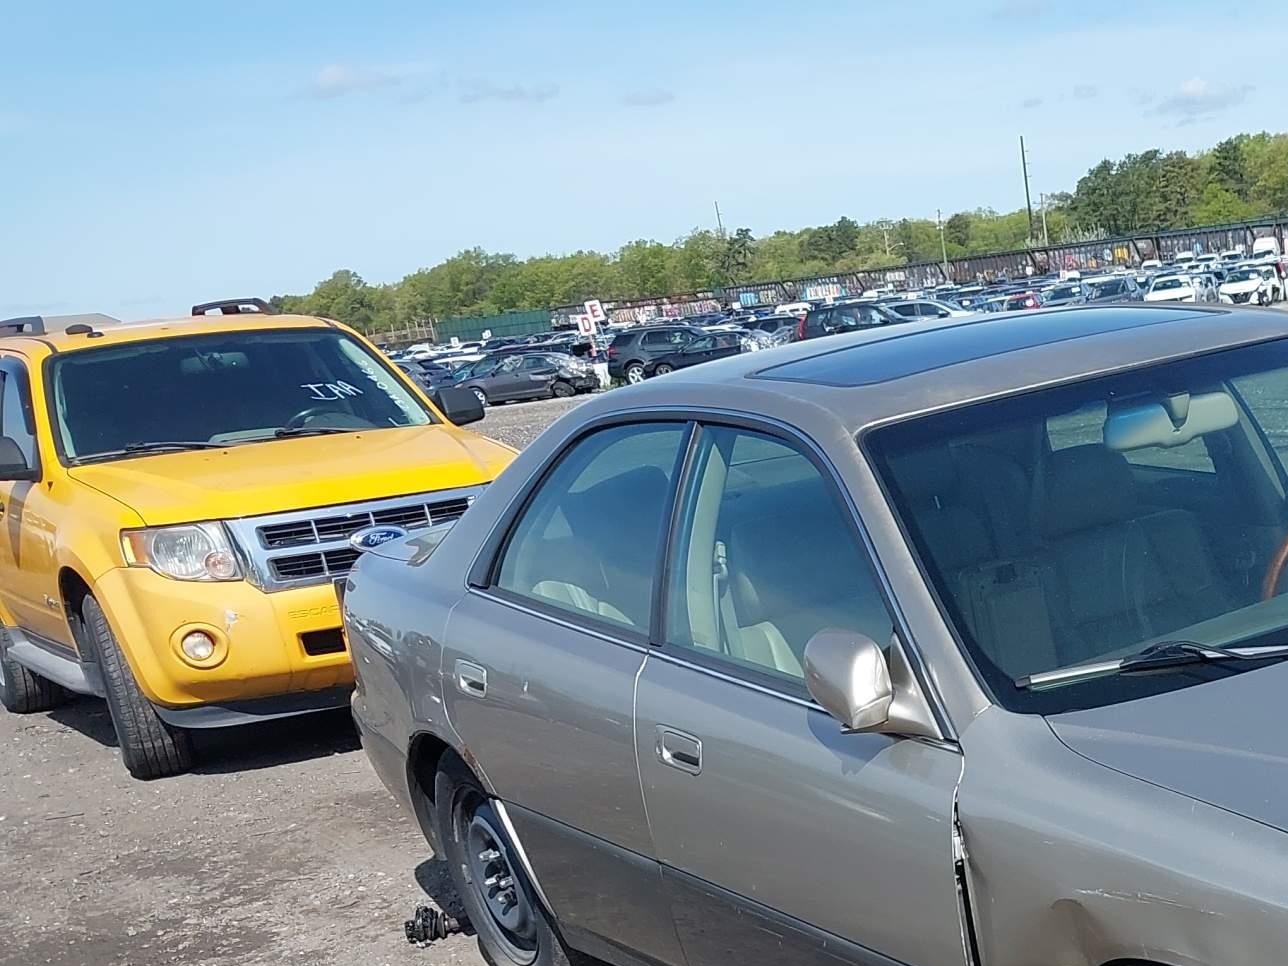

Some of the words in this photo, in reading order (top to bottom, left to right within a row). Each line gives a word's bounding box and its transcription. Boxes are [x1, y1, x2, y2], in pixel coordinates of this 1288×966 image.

[589, 304, 601, 318] E
[580, 317, 592, 332] D
[300, 380, 363, 400] IAA
